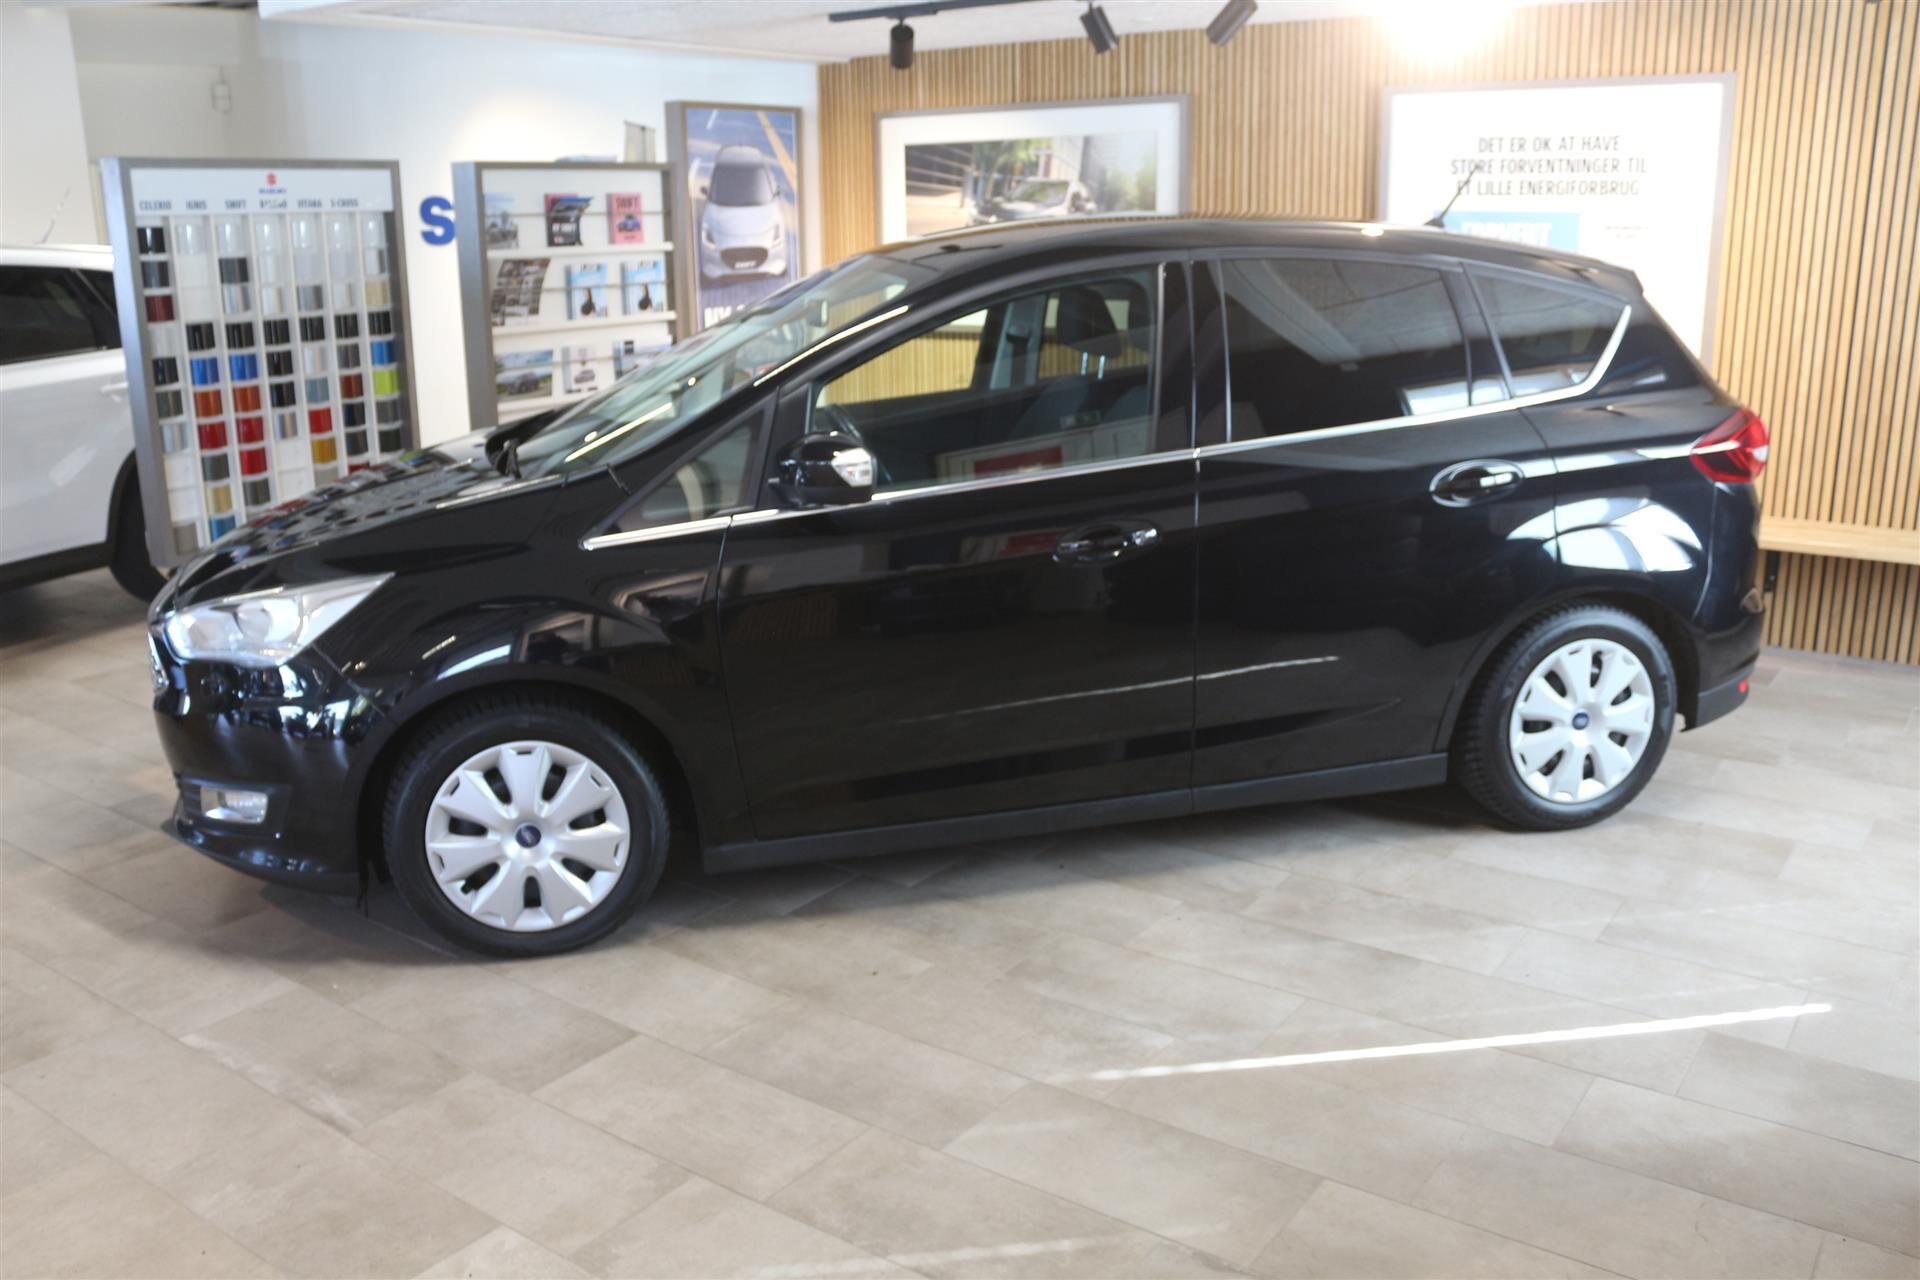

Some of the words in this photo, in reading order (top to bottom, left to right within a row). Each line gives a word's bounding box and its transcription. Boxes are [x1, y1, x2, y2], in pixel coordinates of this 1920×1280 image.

[1478, 137, 1503, 153] DET
[1510, 136, 1527, 152] ER
[1533, 136, 1552, 152] OK
[1558, 136, 1576, 151] AT
[1582, 135, 1620, 151] HAVE
[1450, 158, 1493, 175] STORE
[1500, 157, 1620, 174] FORVENTNINGER
[1628, 157, 1647, 173] TIL
[1477, 179, 1512, 196] LILLE
[1520, 179, 1639, 196] ENERGIFORBRUG
